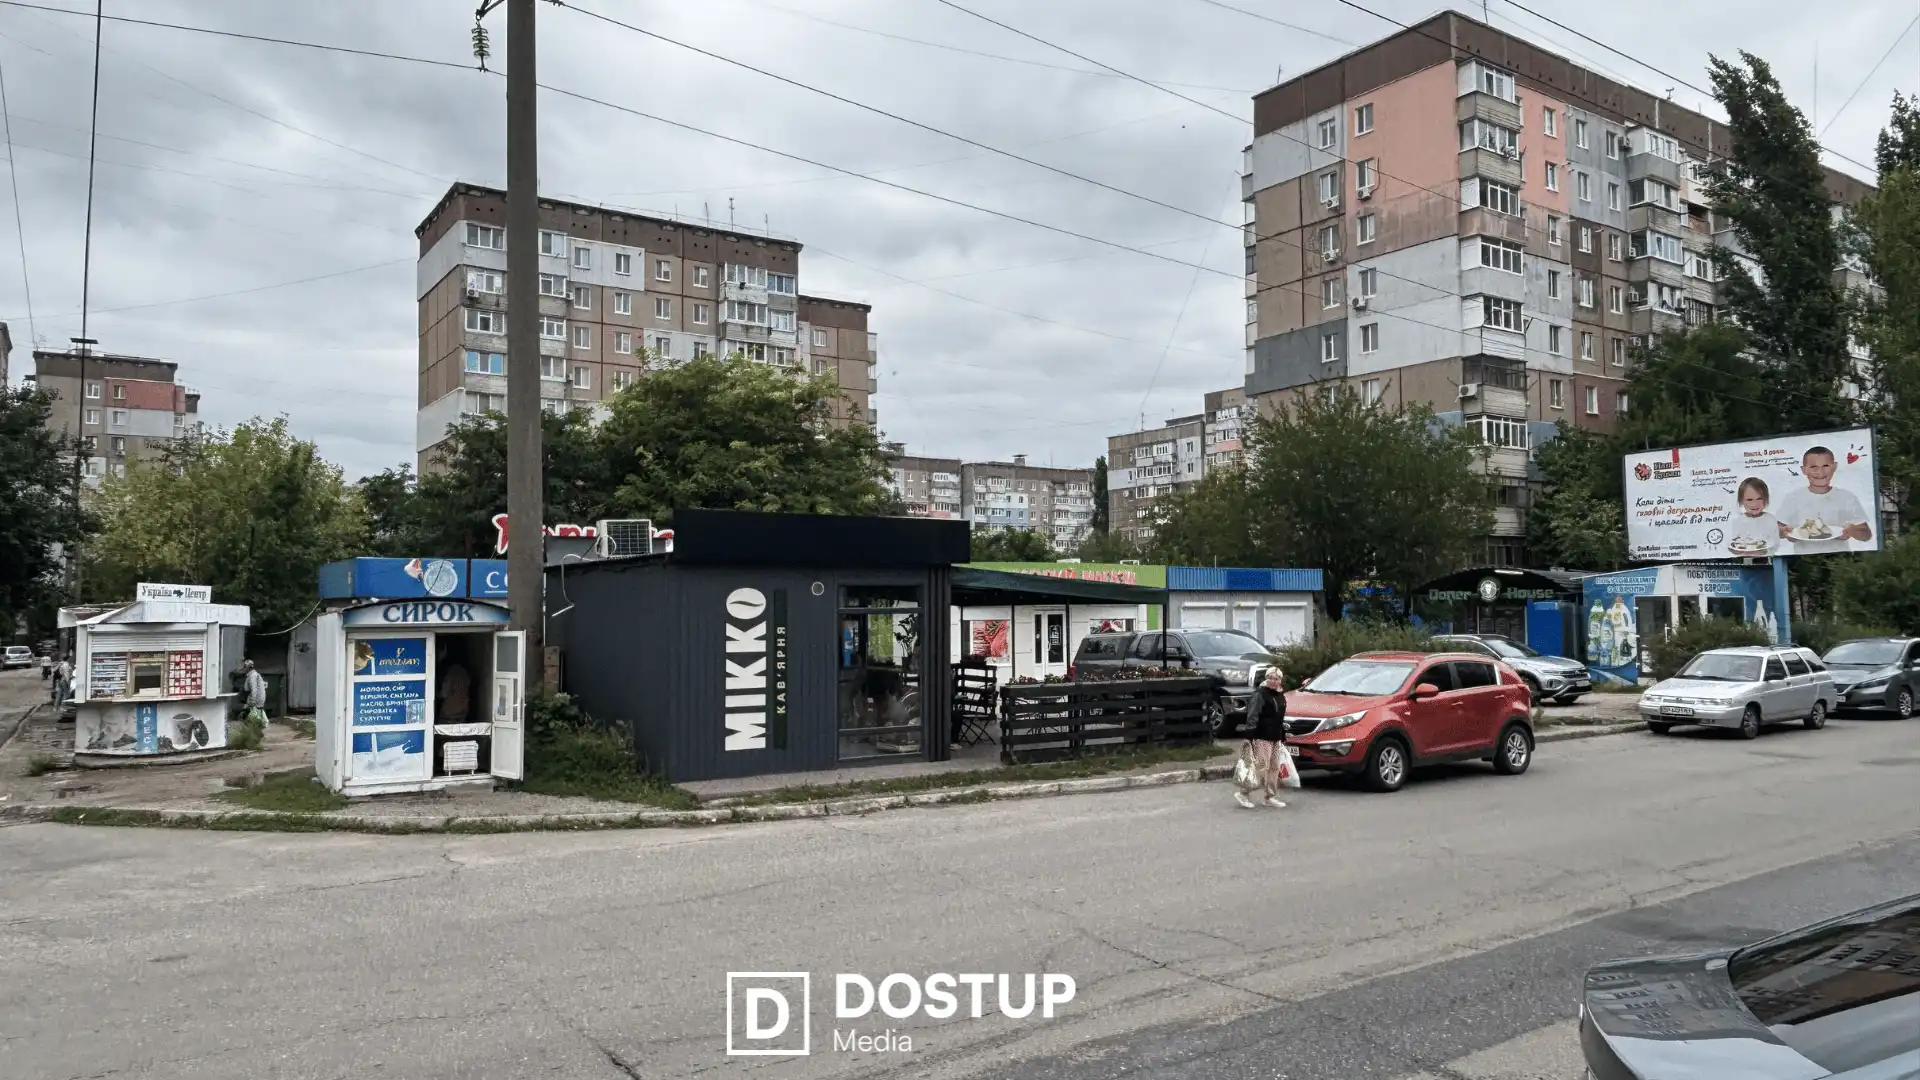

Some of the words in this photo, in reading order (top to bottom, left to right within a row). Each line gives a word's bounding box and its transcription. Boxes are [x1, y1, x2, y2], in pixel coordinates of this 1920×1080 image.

[1667, 505, 1723, 517] дегустатори
[185, 587, 207, 601] Центр
[1507, 587, 1554, 599] House
[382, 602, 475, 622] СИРОК
[724, 587, 767, 752] MIKKO
